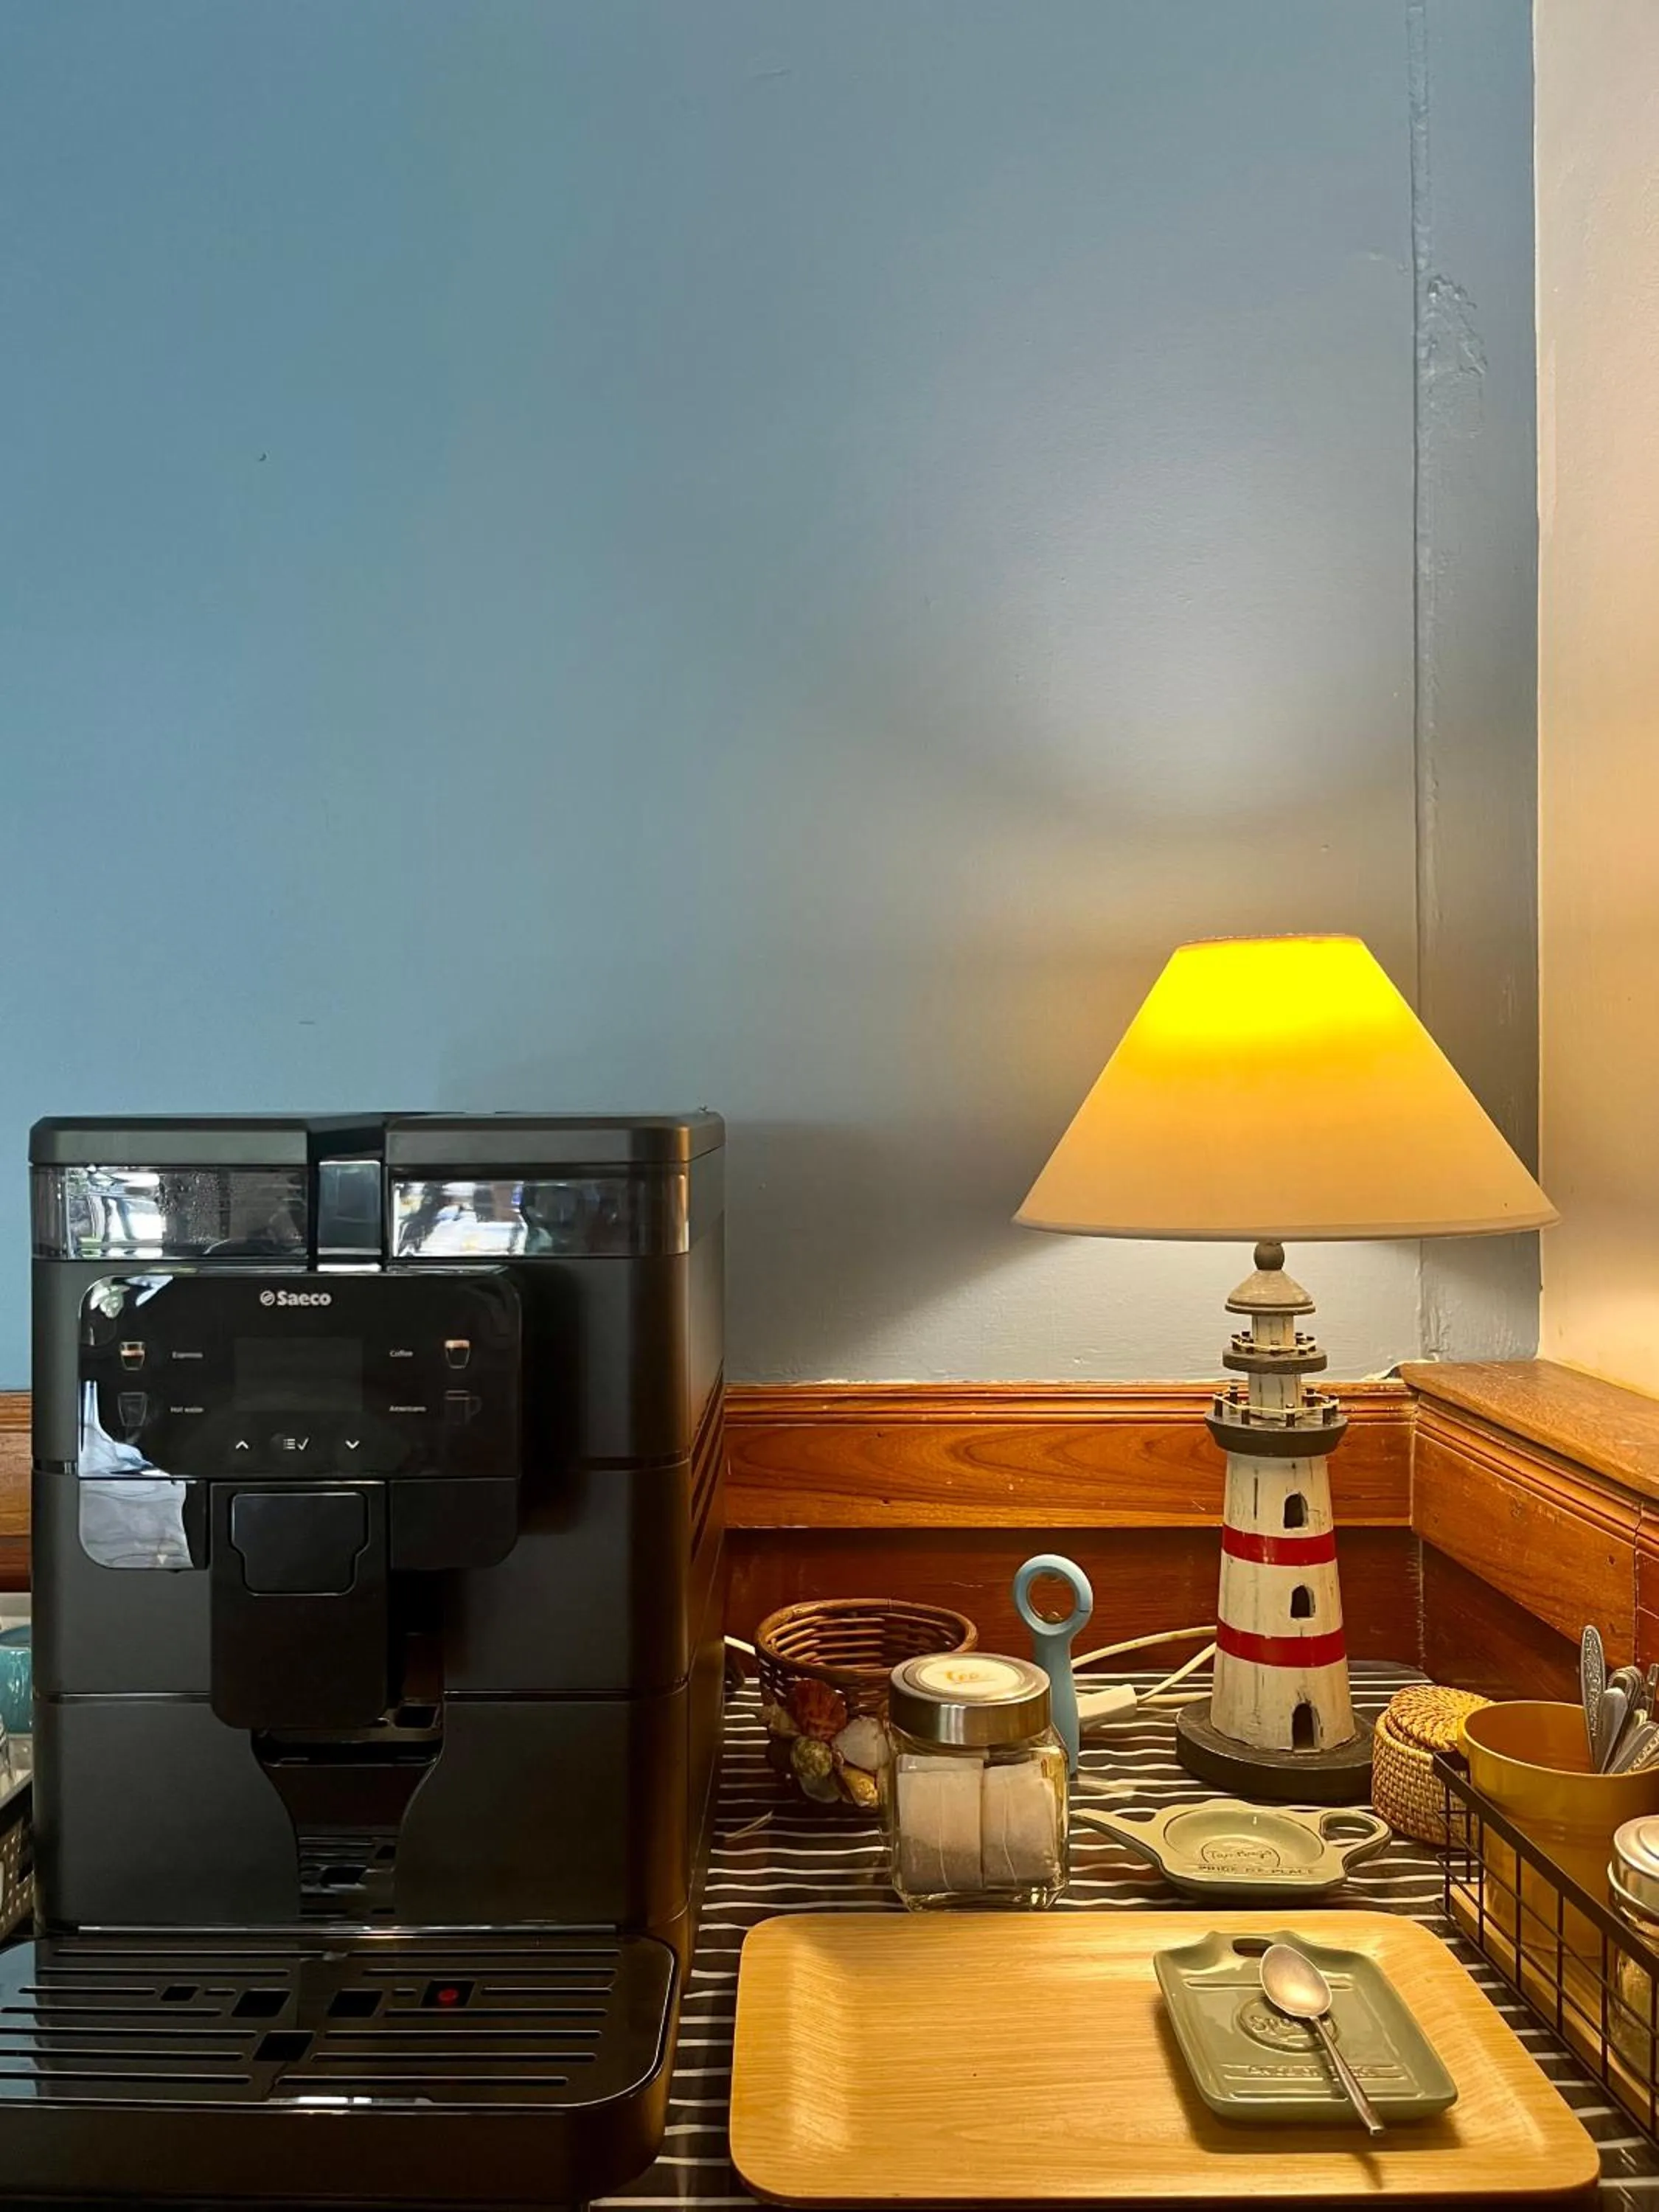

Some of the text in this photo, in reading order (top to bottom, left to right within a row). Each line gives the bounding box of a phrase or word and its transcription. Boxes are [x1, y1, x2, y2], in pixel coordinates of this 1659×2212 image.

[276, 1290, 332, 1306] Saeco
[389, 1349, 414, 1357] Coffee
[389, 1405, 427, 1413] Americano
